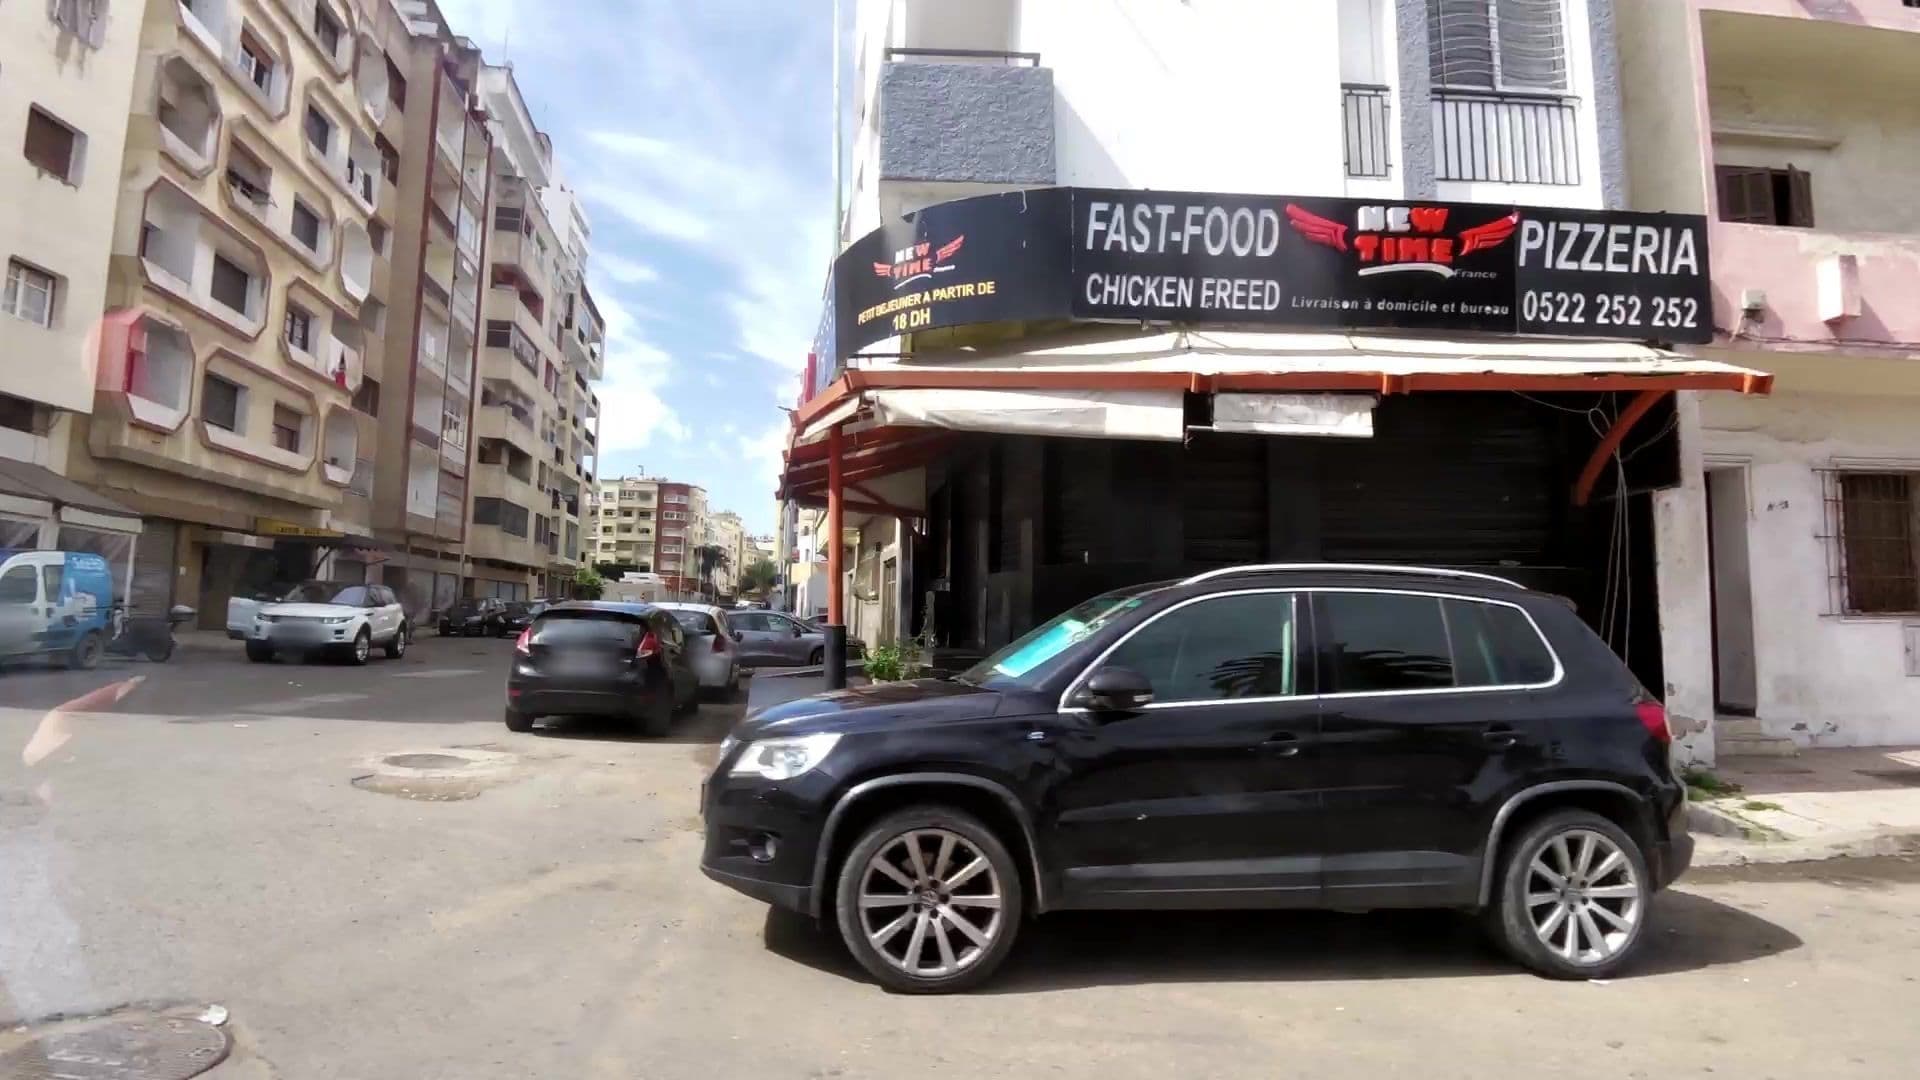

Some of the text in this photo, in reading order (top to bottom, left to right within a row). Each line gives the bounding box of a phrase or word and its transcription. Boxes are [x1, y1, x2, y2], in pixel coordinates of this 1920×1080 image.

[1086, 202, 1280, 257] FAST-FOOD
[1358, 206, 1448, 232] NEW
[895, 242, 930, 264] NEW
[1354, 235, 1453, 262] TIME
[1519, 219, 1698, 275] PIZZERIA
[893, 258, 933, 280] TIME
[1455, 268, 1497, 279] France
[932, 284, 975, 301] PARTIR
[977, 281, 996, 295] DE
[1086, 273, 1281, 311] CHICKEN FREED
[1291, 296, 1358, 310] Livraison
[1377, 298, 1437, 312] domicile
[1442, 300, 1456, 313] et
[1460, 302, 1509, 315] bureau
[1523, 290, 1698, 328] 0522 252 252
[892, 307, 931, 331] 18 DH
